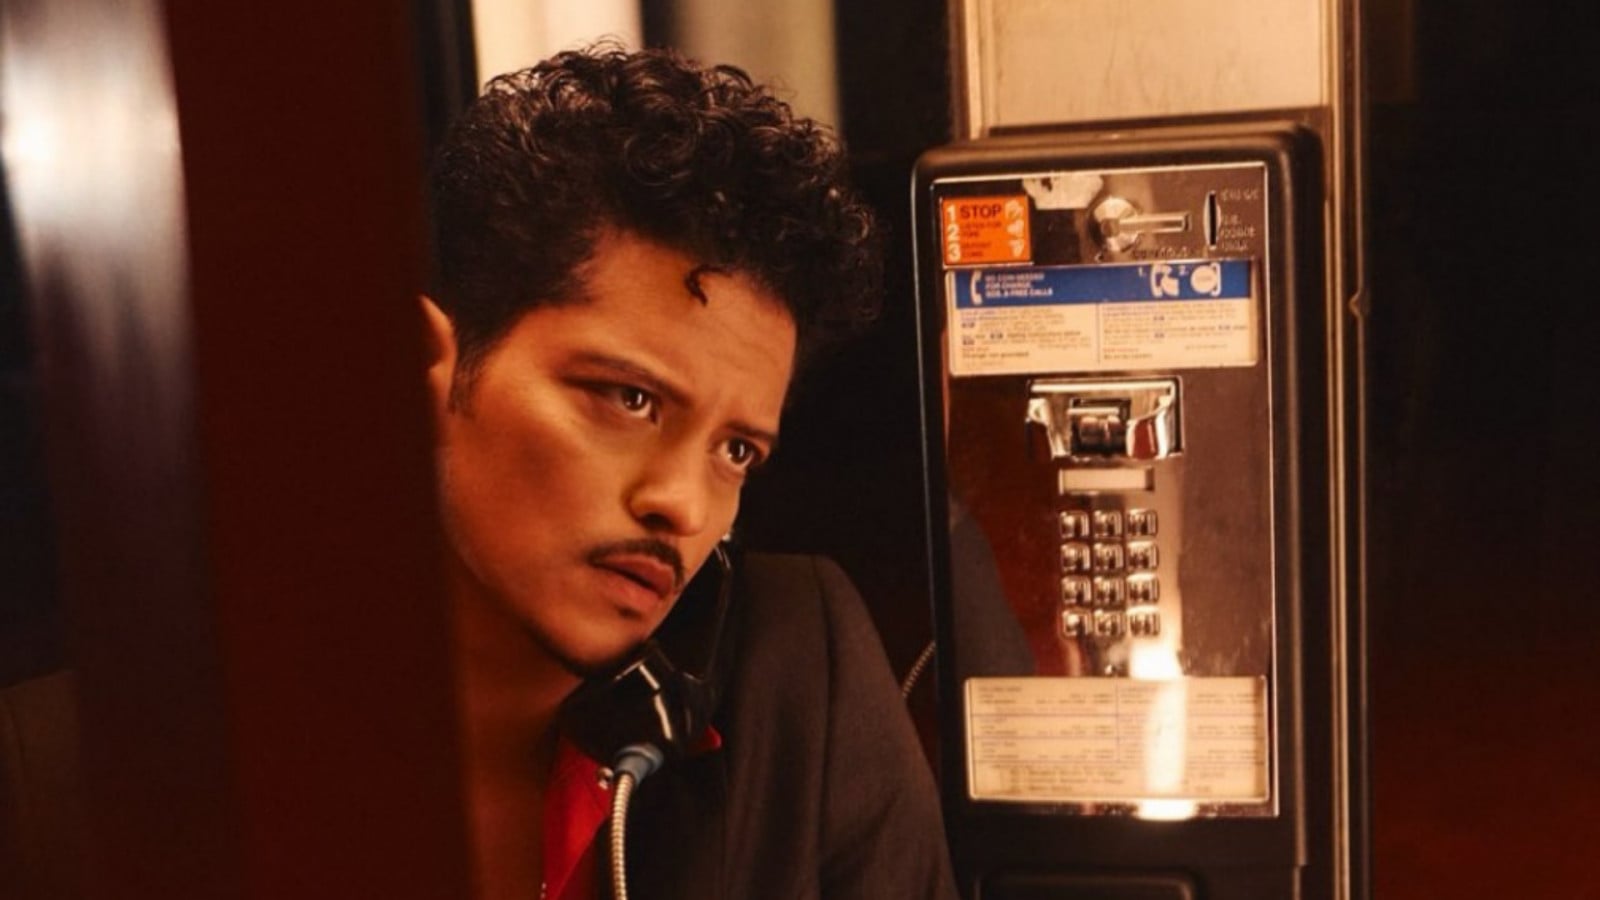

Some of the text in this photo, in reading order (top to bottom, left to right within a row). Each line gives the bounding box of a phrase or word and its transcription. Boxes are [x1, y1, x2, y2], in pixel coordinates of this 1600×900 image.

[946, 204, 1002, 221] 1 STOP
[946, 223, 960, 240] 2
[948, 241, 961, 262] 3
